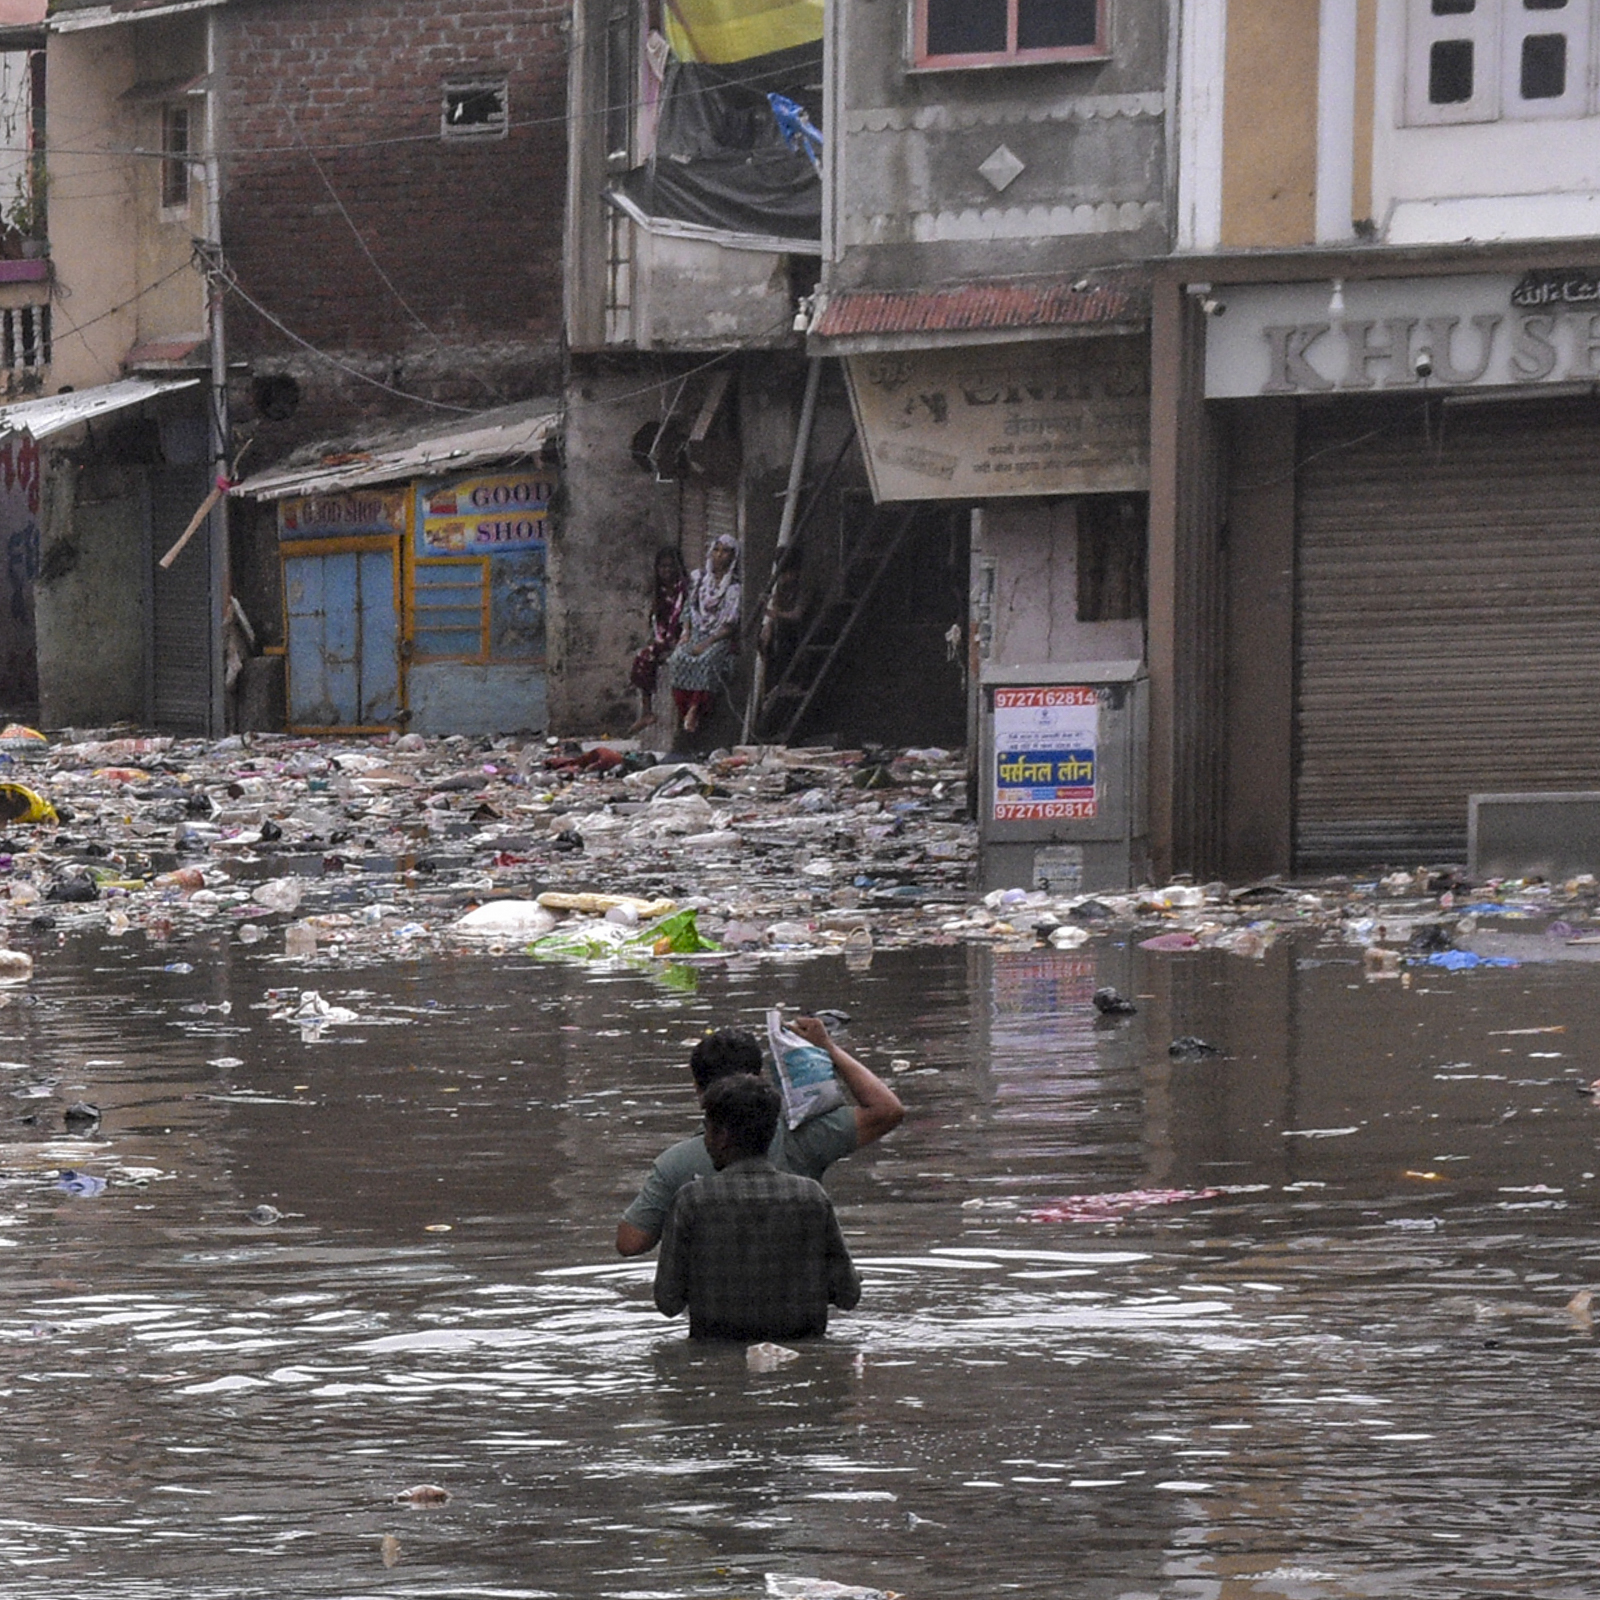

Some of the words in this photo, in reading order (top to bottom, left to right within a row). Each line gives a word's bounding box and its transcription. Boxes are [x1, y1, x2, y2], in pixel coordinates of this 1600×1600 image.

[471, 482, 550, 507] GOOD
[343, 500, 383, 524] SHOP
[996, 690, 1095, 707] 9727162814
[1057, 755, 1093, 782] लोन
[995, 802, 1095, 819] 9727162814
